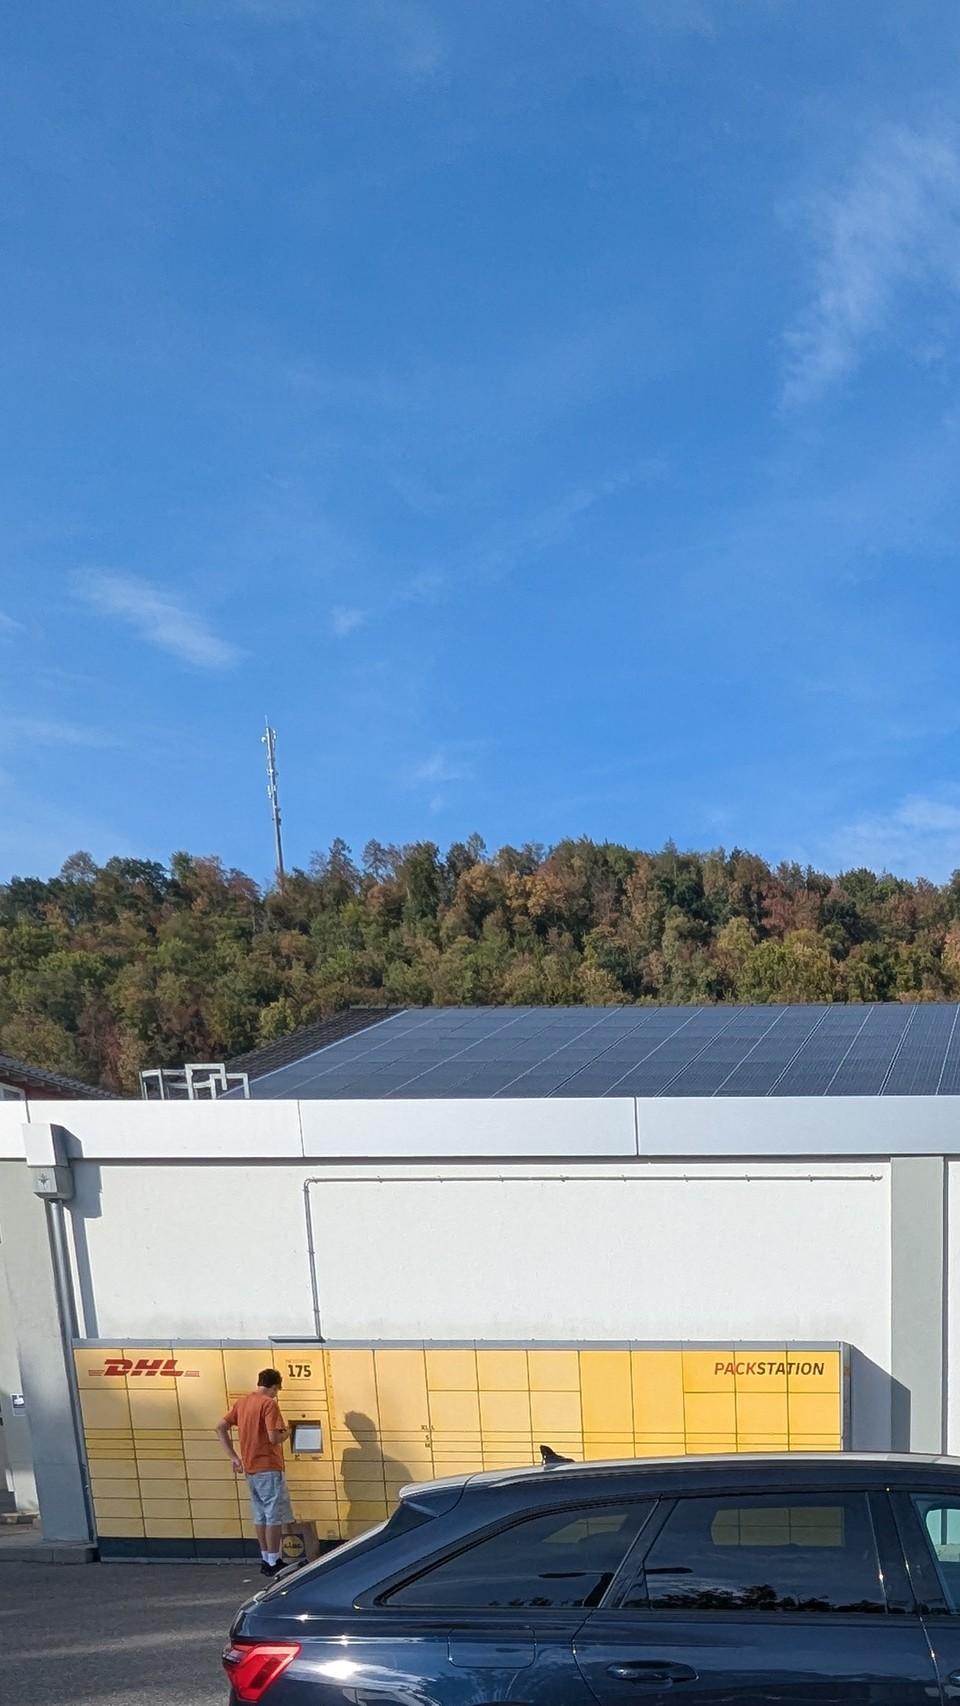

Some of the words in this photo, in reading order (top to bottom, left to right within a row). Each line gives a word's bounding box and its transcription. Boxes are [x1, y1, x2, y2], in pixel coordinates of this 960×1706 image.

[103, 1359, 184, 1377] DHL
[288, 1364, 311, 1377] 175
[714, 1362, 825, 1376] PACKSTATION
